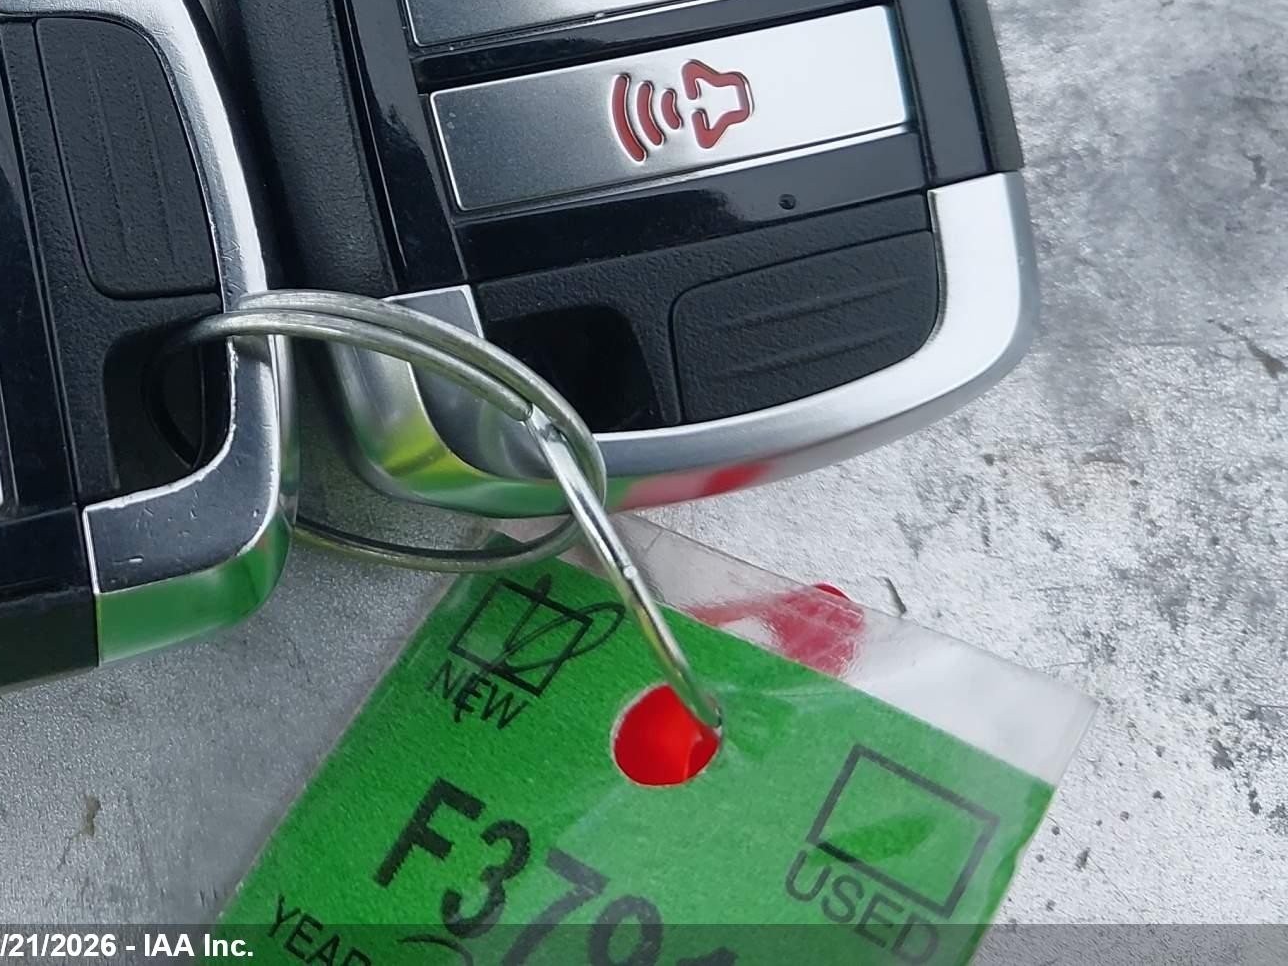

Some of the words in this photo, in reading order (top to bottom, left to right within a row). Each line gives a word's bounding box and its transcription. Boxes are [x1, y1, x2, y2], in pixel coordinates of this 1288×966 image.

[426, 658, 530, 731] NEW
[373, 777, 738, 966] F379
[784, 849, 939, 965] USED
